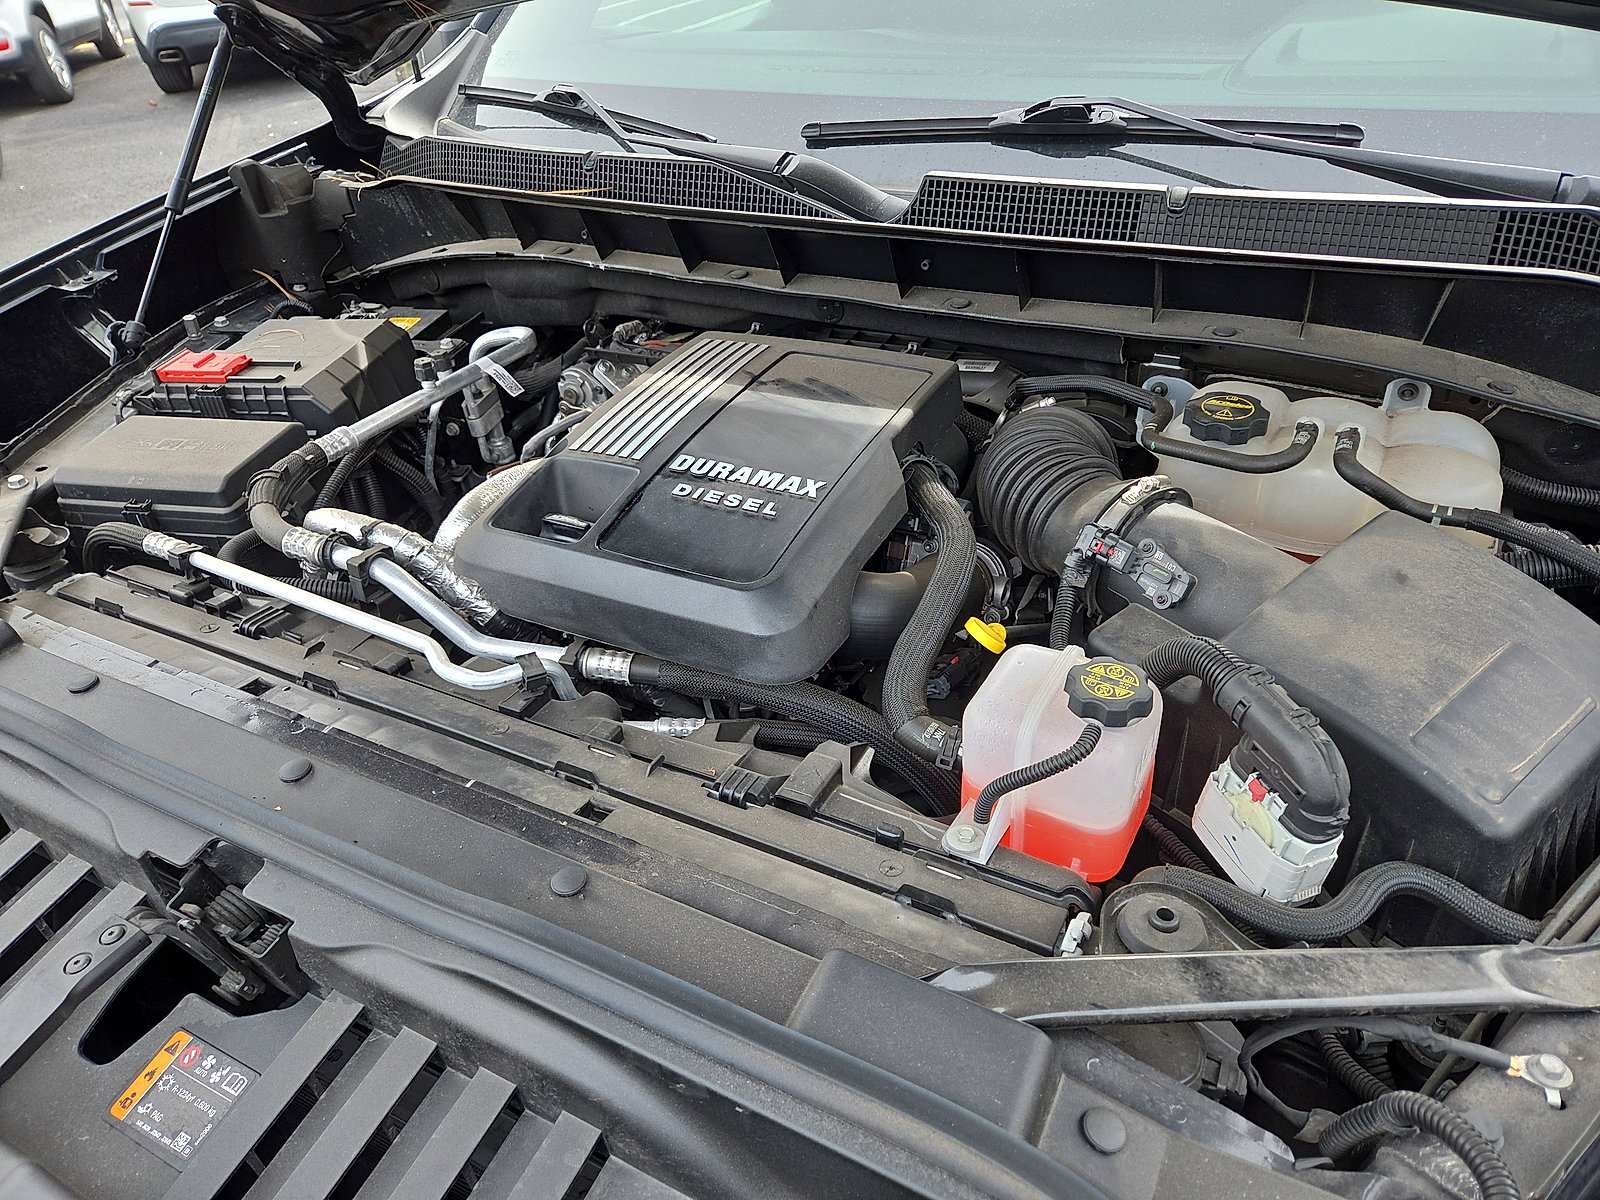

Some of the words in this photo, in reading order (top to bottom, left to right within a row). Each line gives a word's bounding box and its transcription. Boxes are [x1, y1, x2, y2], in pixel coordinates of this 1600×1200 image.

[669, 454, 828, 499] DURAMAX
[672, 483, 778, 516] DIESEL
[194, 1067, 208, 1078] AUTO
[150, 1108, 164, 1122] PAG
[207, 1108, 217, 1118] kg
